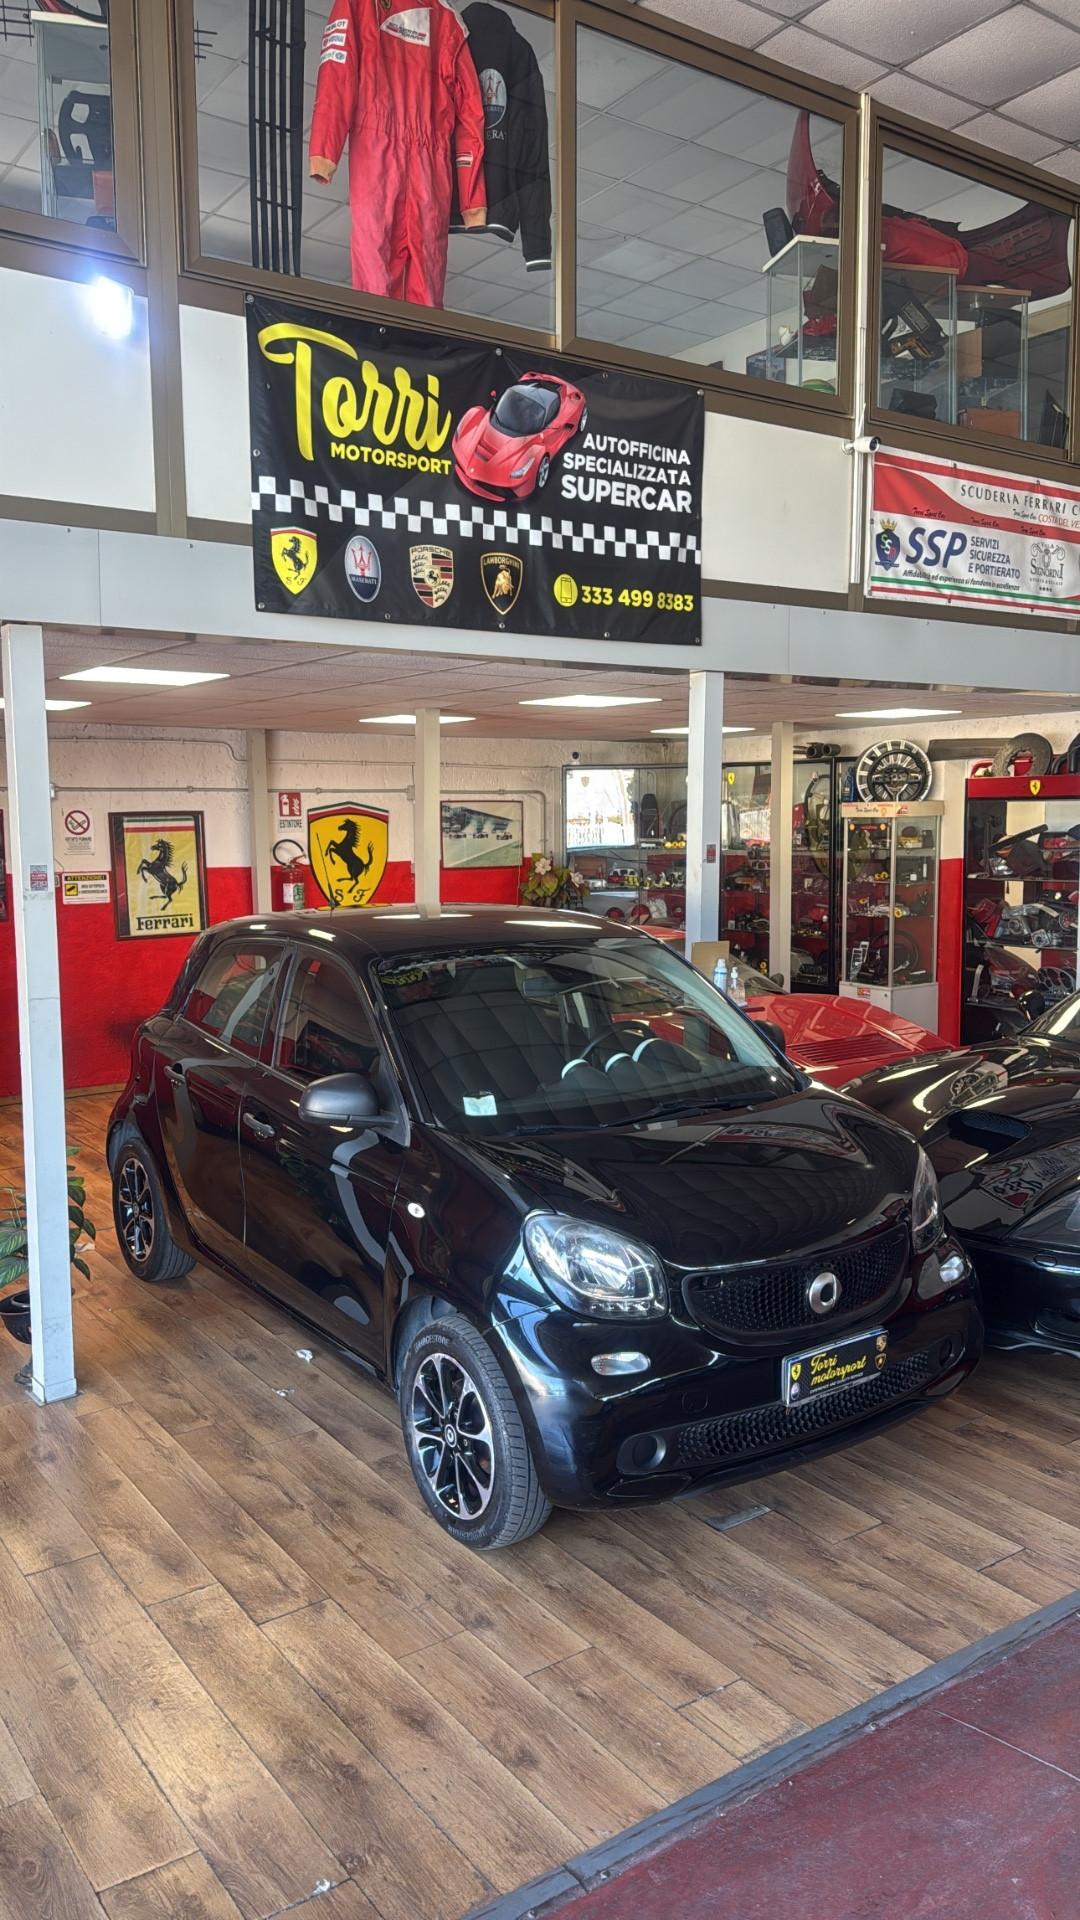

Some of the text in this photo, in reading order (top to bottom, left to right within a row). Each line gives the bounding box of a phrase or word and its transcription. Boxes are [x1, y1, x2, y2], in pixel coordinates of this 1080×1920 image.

[258, 322, 452, 461] Torri
[330, 442, 452, 475] MOTORSPORT
[583, 432, 691, 465] AUTOFFICINA
[562, 452, 692, 486] SPECIALIZZATA
[561, 474, 692, 514] SUPERCAR
[960, 484, 1020, 506] SCUDERIA
[1024, 495, 1067, 515] FERRARI
[411, 546, 452, 558] PORSCHE
[905, 527, 967, 568] SSP
[970, 536, 999, 550] SERVIZI
[483, 556, 520, 569] LAMBORGHINI
[967, 563, 1021, 579] E PORTIERATO
[969, 550, 1011, 565] SICUREZZA
[351, 576, 378, 586] MASERATI
[581, 585, 695, 612] 333 499 8383
[279, 818, 303, 829] ESTINTORE
[135, 912, 195, 932] Ferrari
[809, 1354, 868, 1387] motorsport
